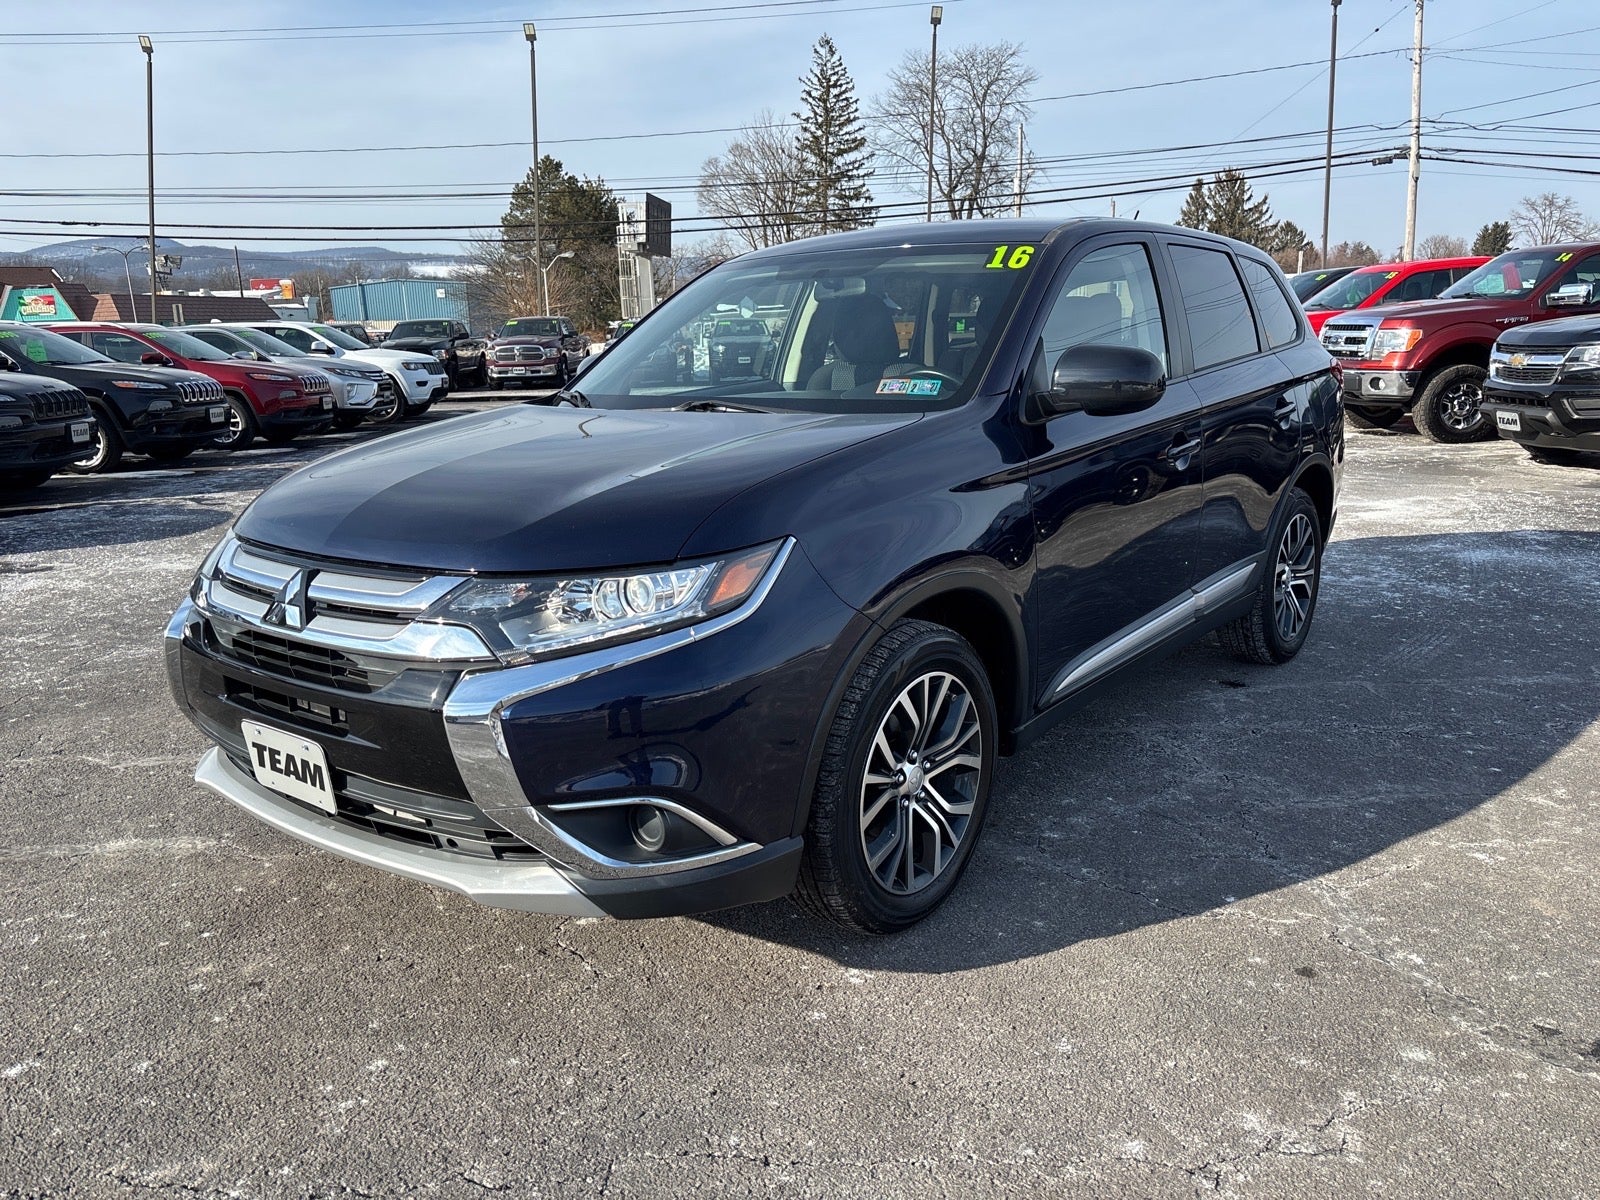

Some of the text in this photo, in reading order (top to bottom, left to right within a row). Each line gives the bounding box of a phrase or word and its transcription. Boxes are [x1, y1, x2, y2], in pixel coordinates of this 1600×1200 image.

[986, 245, 1035, 269] 16
[1554, 252, 1573, 262] 14
[880, 383, 888, 392] 2
[910, 383, 918, 393] 2
[210, 411, 224, 419] TEAM
[1498, 416, 1518, 426] TEAM
[72, 428, 89, 437] TEAM
[252, 741, 326, 792] TEAM
